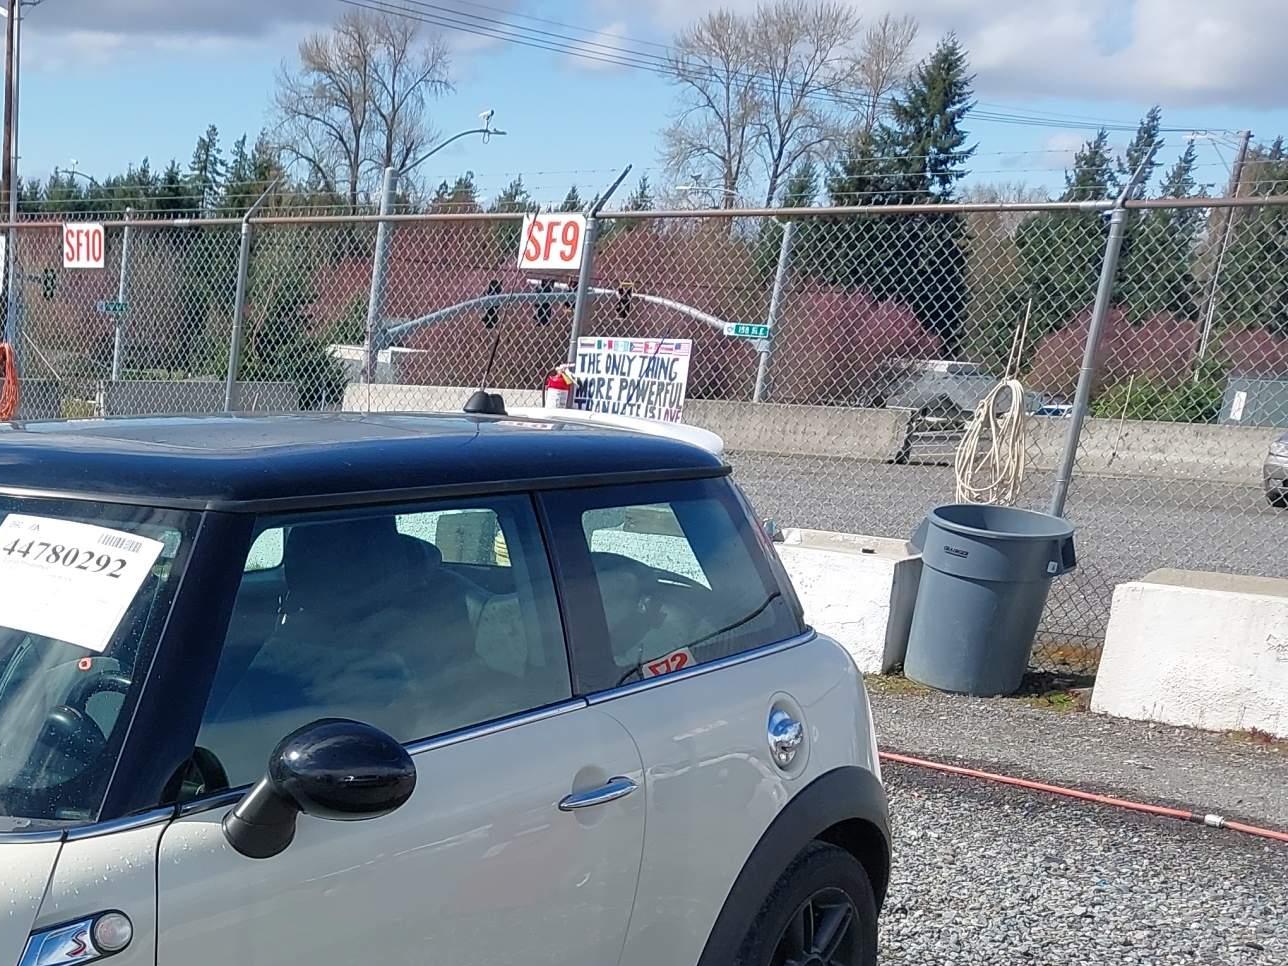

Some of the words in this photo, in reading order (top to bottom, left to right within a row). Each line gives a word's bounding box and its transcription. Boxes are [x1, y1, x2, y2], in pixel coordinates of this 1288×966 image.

[65, 229, 102, 262] SF10
[525, 220, 579, 261] SF9
[578, 353, 602, 374] THE
[605, 353, 637, 377] ONLY
[638, 355, 680, 382] THING
[576, 377, 614, 400] MORE
[618, 378, 682, 409] POWERFUL
[644, 403, 656, 418] IS
[3, 538, 127, 579] 44780292
